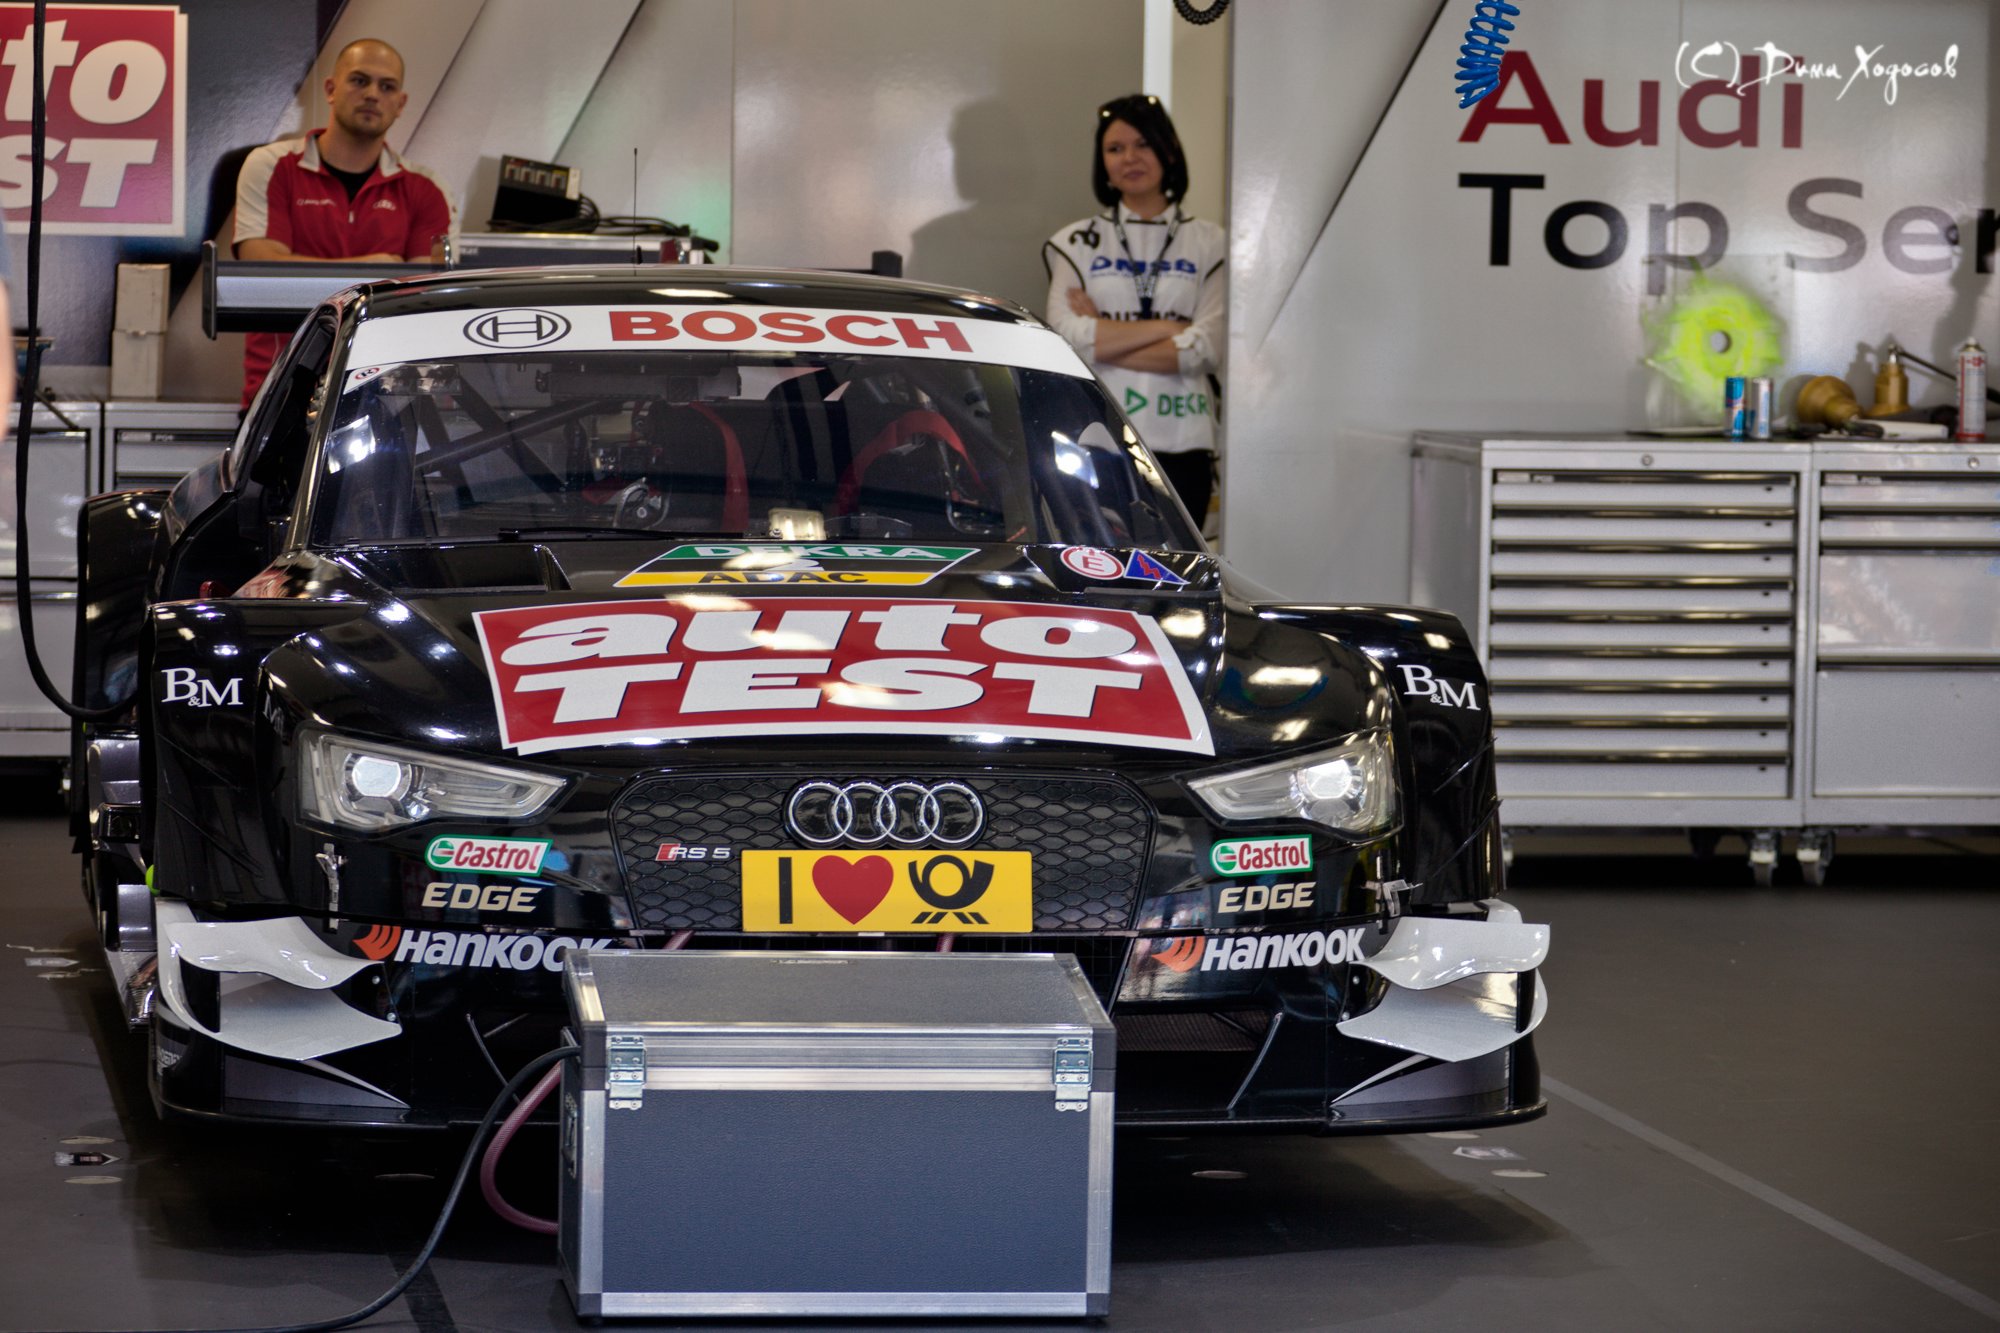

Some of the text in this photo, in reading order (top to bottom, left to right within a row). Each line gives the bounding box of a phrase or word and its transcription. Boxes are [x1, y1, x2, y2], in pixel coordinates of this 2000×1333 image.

[0, 19, 167, 125] to
[1457, 50, 1805, 149] Audi
[1458, 172, 1730, 296] Top
[608, 309, 974, 353] BOSCH
[693, 545, 946, 559] DEKRA
[697, 572, 869, 584] ADAC
[501, 604, 1137, 665] auto
[160, 667, 244, 707] B&M
[514, 657, 1143, 723] TEST
[1396, 664, 1481, 711] B&M
[454, 841, 541, 871] Castrol
[667, 846, 732, 859] RS 5
[1238, 840, 1309, 871] Castrol
[421, 882, 542, 913] EDGE
[1218, 881, 1317, 914] EDGE
